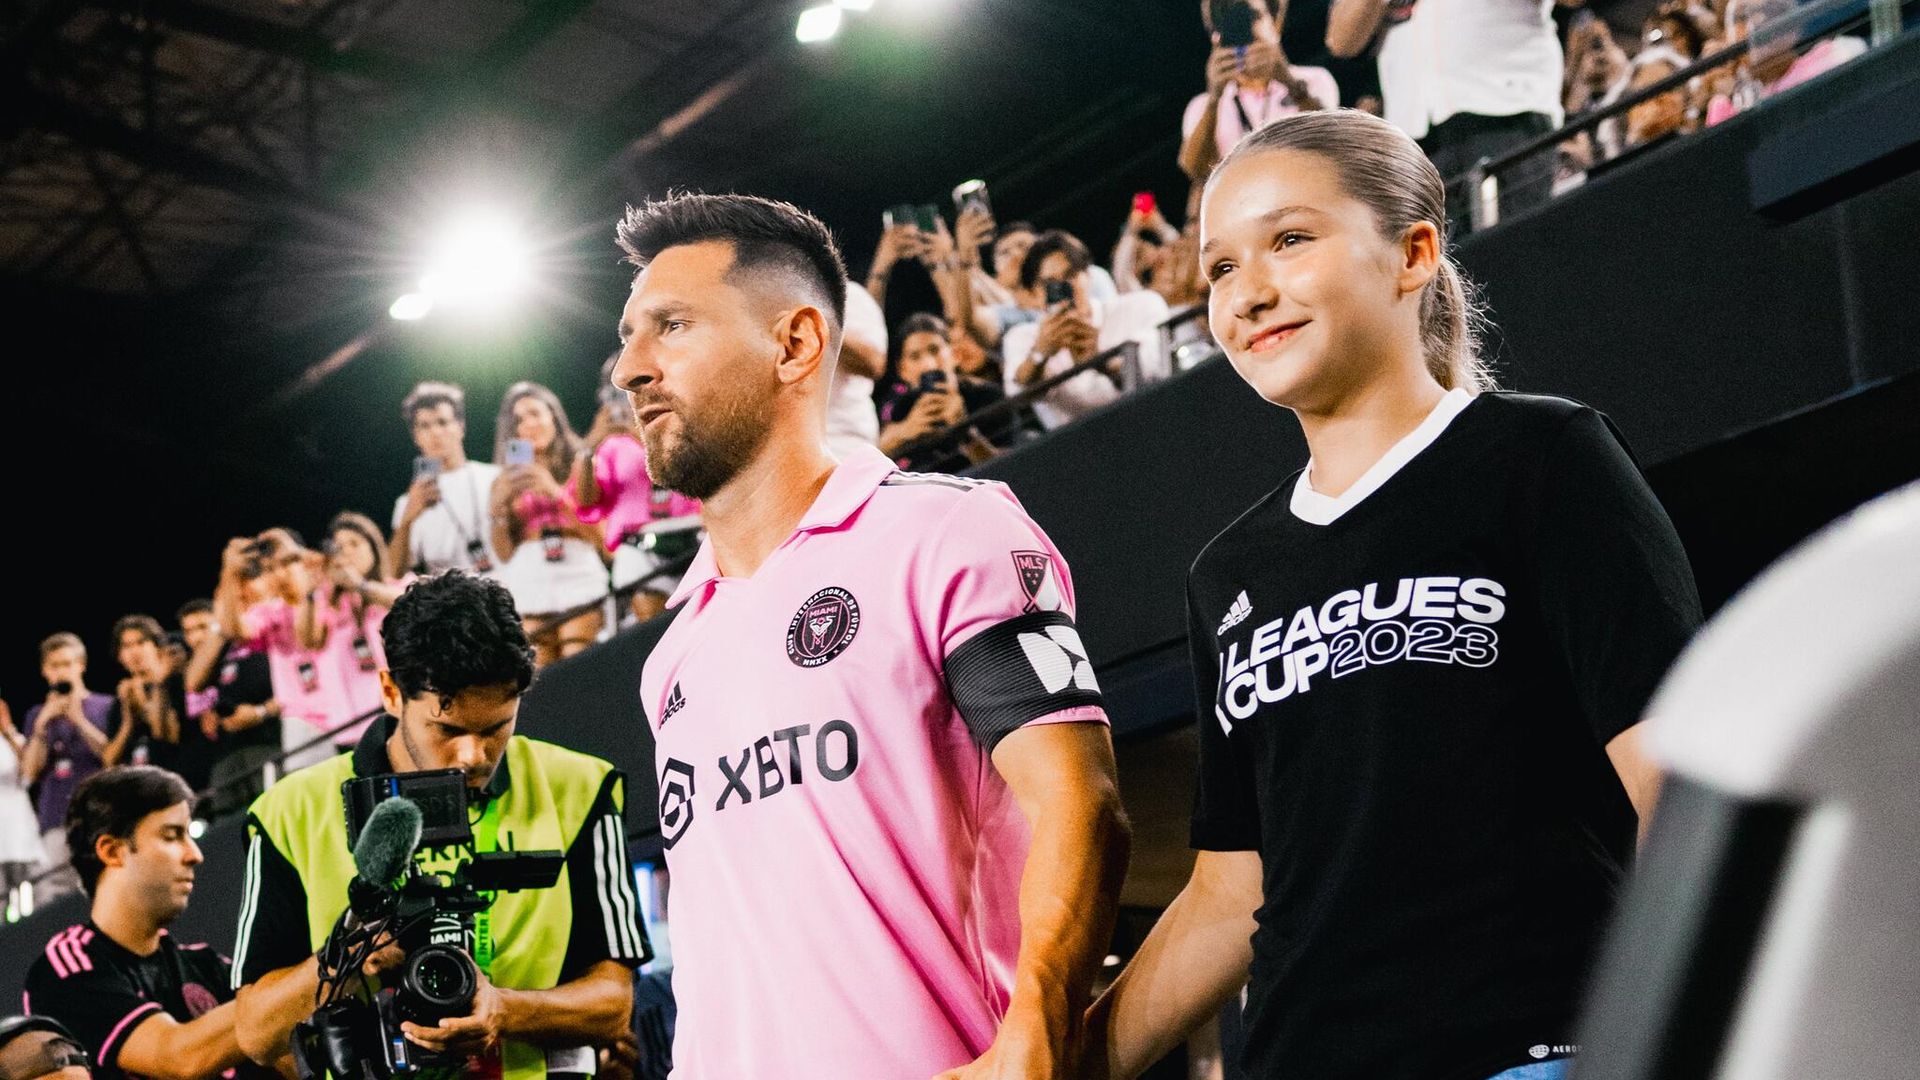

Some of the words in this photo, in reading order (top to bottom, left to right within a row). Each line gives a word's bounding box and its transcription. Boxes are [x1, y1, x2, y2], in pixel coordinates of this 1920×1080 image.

[1019, 556, 1044, 570] MLS
[790, 588, 849, 630] INTERNACIONAL
[847, 599, 857, 610] DE
[809, 606, 838, 618] MIAMI
[1217, 605, 1253, 636] adidas
[1226, 577, 1506, 683] LEAGUES
[1225, 641, 1330, 720] CUP
[1330, 620, 1499, 679] 2023
[716, 719, 859, 811] XBTO
[430, 932, 461, 945] IAMI
[479, 918, 489, 956] INTER
